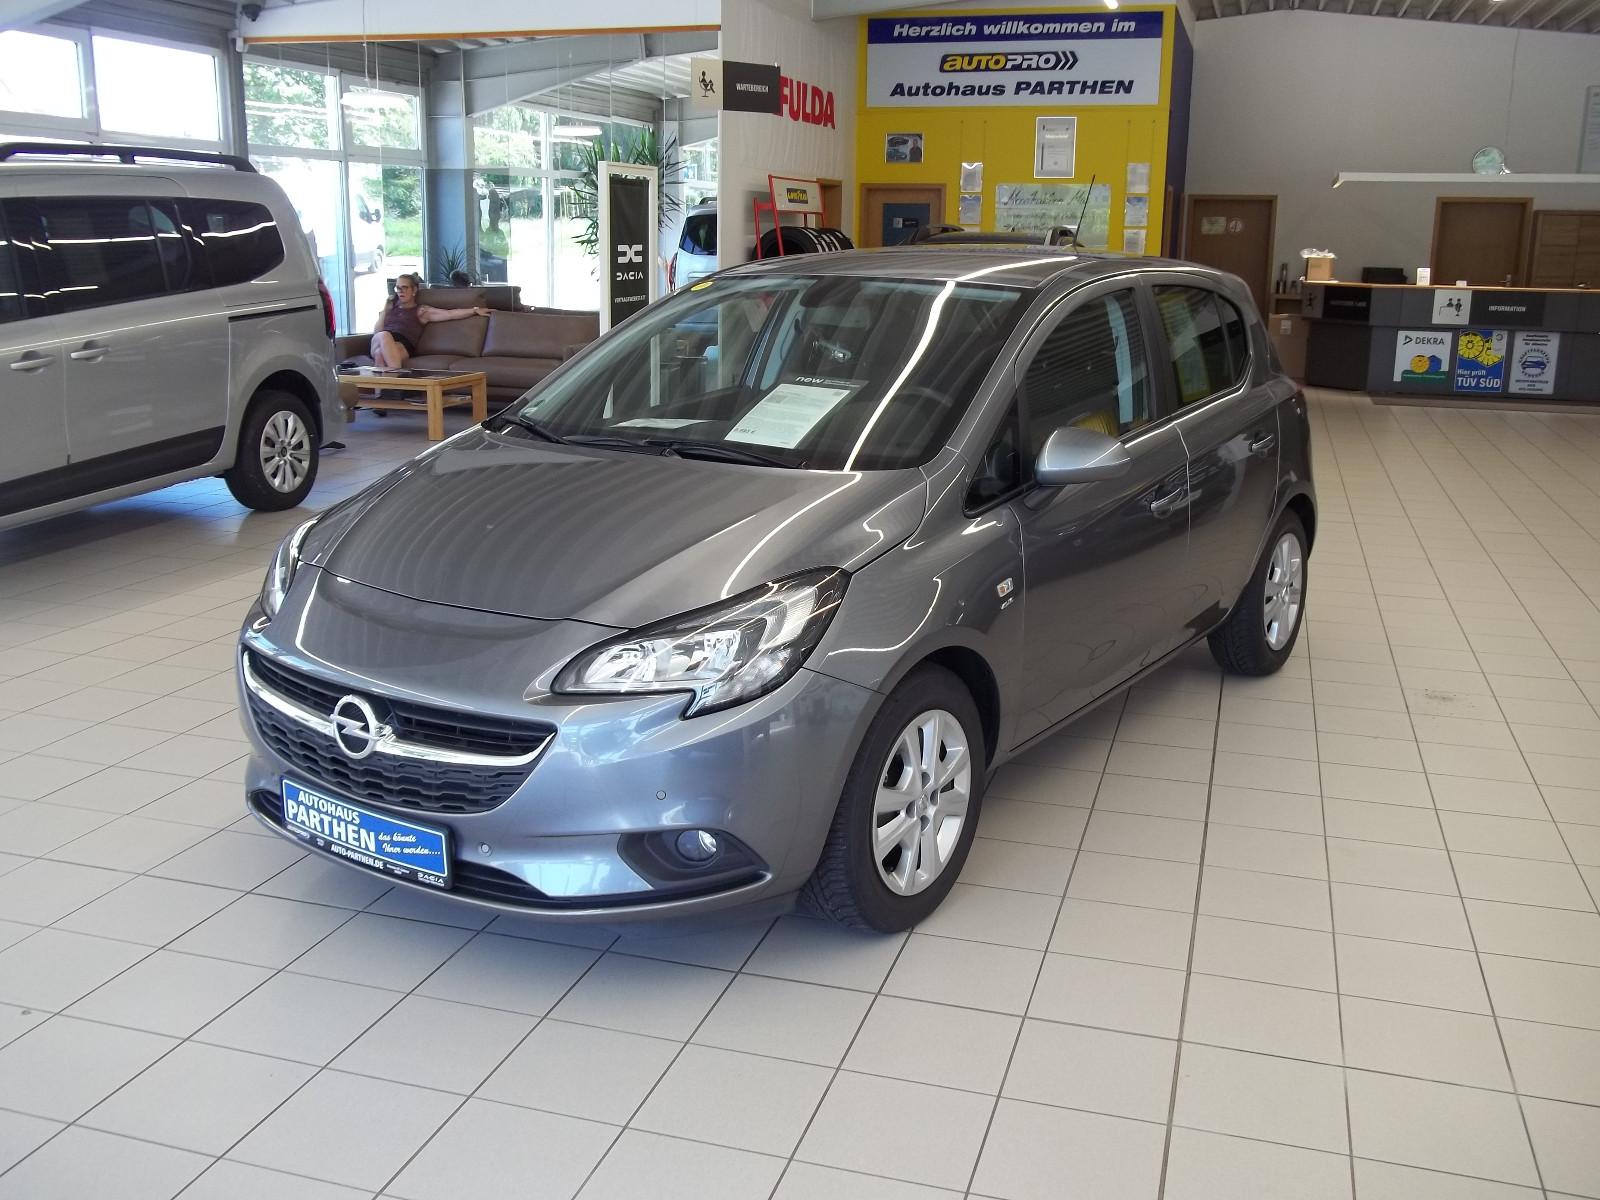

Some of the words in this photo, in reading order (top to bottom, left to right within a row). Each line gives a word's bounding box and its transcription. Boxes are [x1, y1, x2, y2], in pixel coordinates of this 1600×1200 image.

[893, 22, 977, 37] Herzlich
[983, 20, 1105, 35] willkommen
[1111, 19, 1136, 32] im
[890, 81, 1006, 97] Autohaus
[1014, 80, 1134, 95] PARTHEN
[779, 75, 836, 130] FULDA
[616, 271, 644, 281] DACIA
[1415, 336, 1445, 346] DEKRA
[1456, 375, 1477, 388] TÜV
[1479, 376, 1501, 388] SÜD
[298, 790, 360, 825] AUTOHAUS
[287, 798, 376, 853] PARTHEN
[378, 831, 391, 841] das
[331, 843, 384, 870] AUTO-PARTHEN.DE
